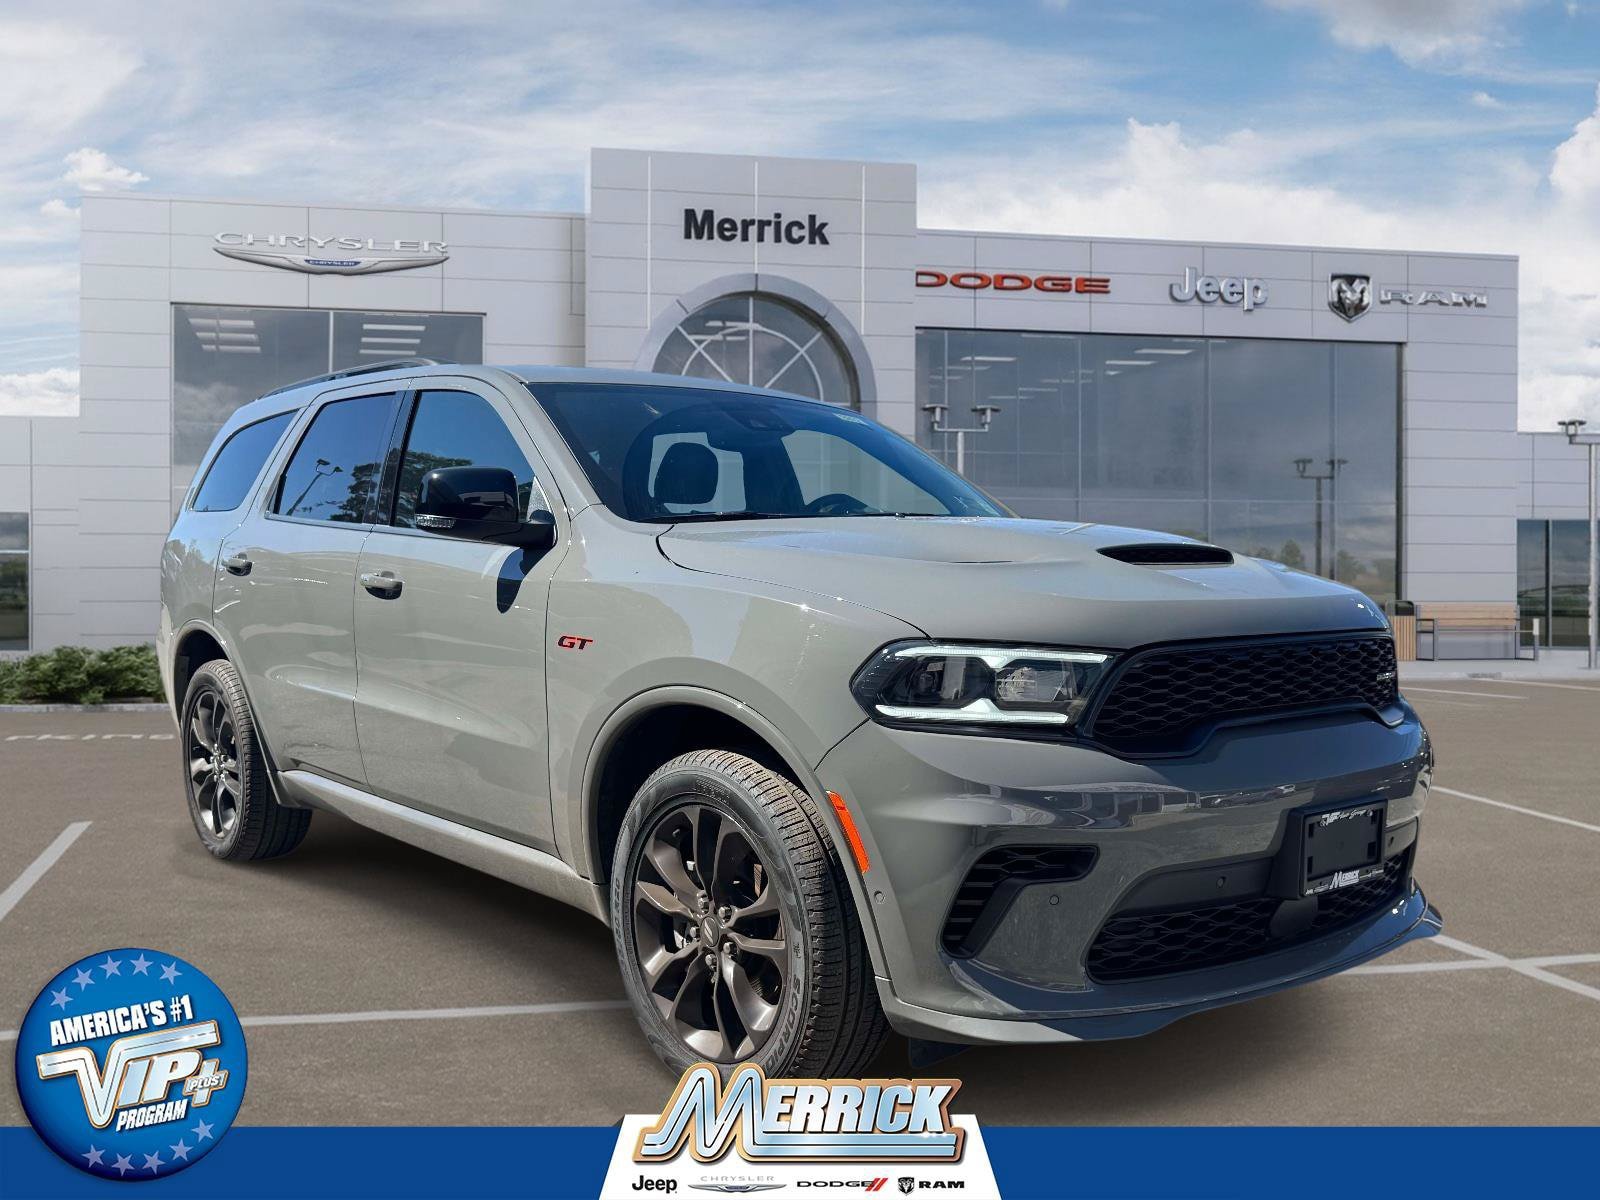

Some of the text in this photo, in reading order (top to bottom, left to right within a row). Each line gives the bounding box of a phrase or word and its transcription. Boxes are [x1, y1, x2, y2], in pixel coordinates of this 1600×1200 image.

[684, 208, 830, 245] Merrick
[214, 232, 449, 253] CHRYSLER
[308, 259, 357, 267] CHRYSLER
[915, 271, 1111, 294] DODGE
[1169, 266, 1269, 312] Jeep
[1379, 289, 1487, 308] RAM
[557, 635, 594, 650] GT
[1329, 870, 1360, 890] MERRICK
